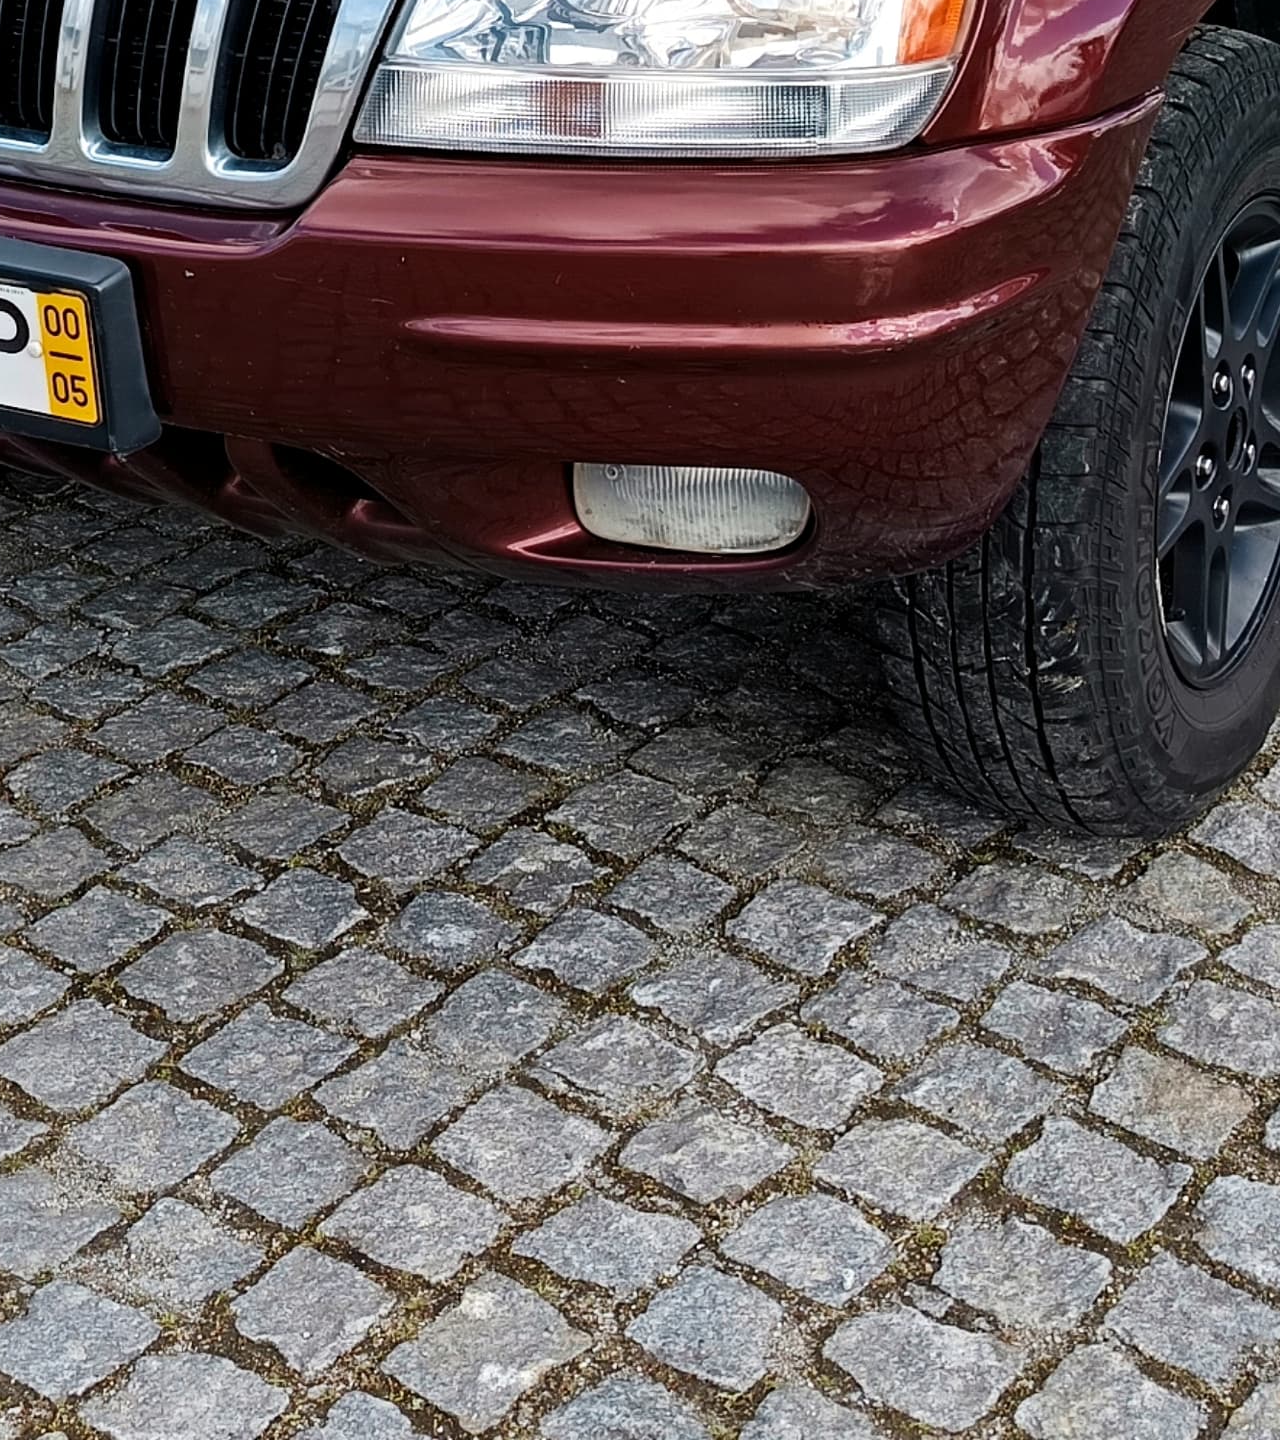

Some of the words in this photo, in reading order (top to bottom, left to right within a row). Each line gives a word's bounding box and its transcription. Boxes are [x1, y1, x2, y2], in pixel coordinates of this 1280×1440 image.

[43, 304, 81, 340] 00
[52, 372, 88, 407] 05
[1136, 298, 1187, 753] YOKOHAMA
